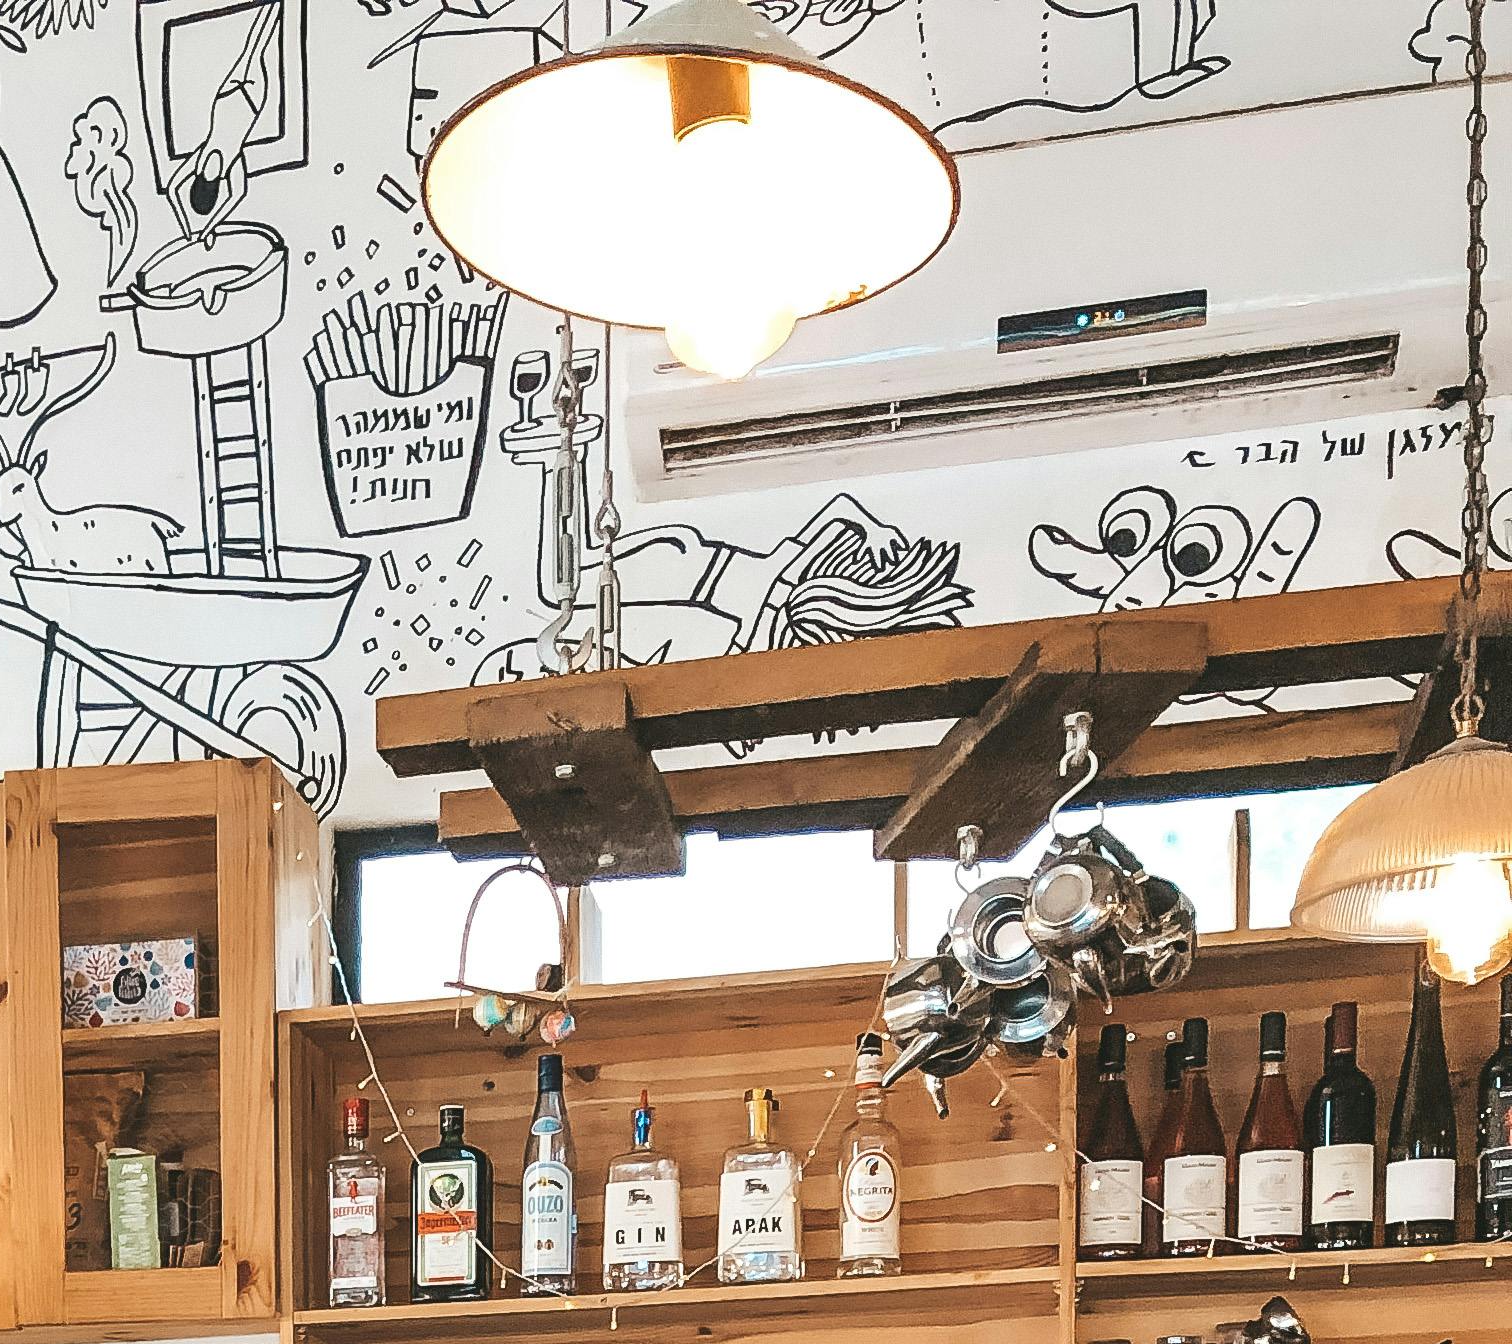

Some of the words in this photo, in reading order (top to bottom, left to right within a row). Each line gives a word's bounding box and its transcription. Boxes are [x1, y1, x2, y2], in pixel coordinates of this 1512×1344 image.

[334, 405, 431, 438] שממהר
[436, 396, 474, 424] ומי
[335, 445, 395, 472] יפתח
[404, 435, 464, 466] שלא
[1234, 439, 1300, 465] הבר
[1321, 429, 1366, 463] של
[333, 1206, 374, 1217] BEEFEATER
[527, 1194, 564, 1215] OUZO
[616, 1227, 666, 1244] GIN
[732, 1216, 783, 1235] ARAK
